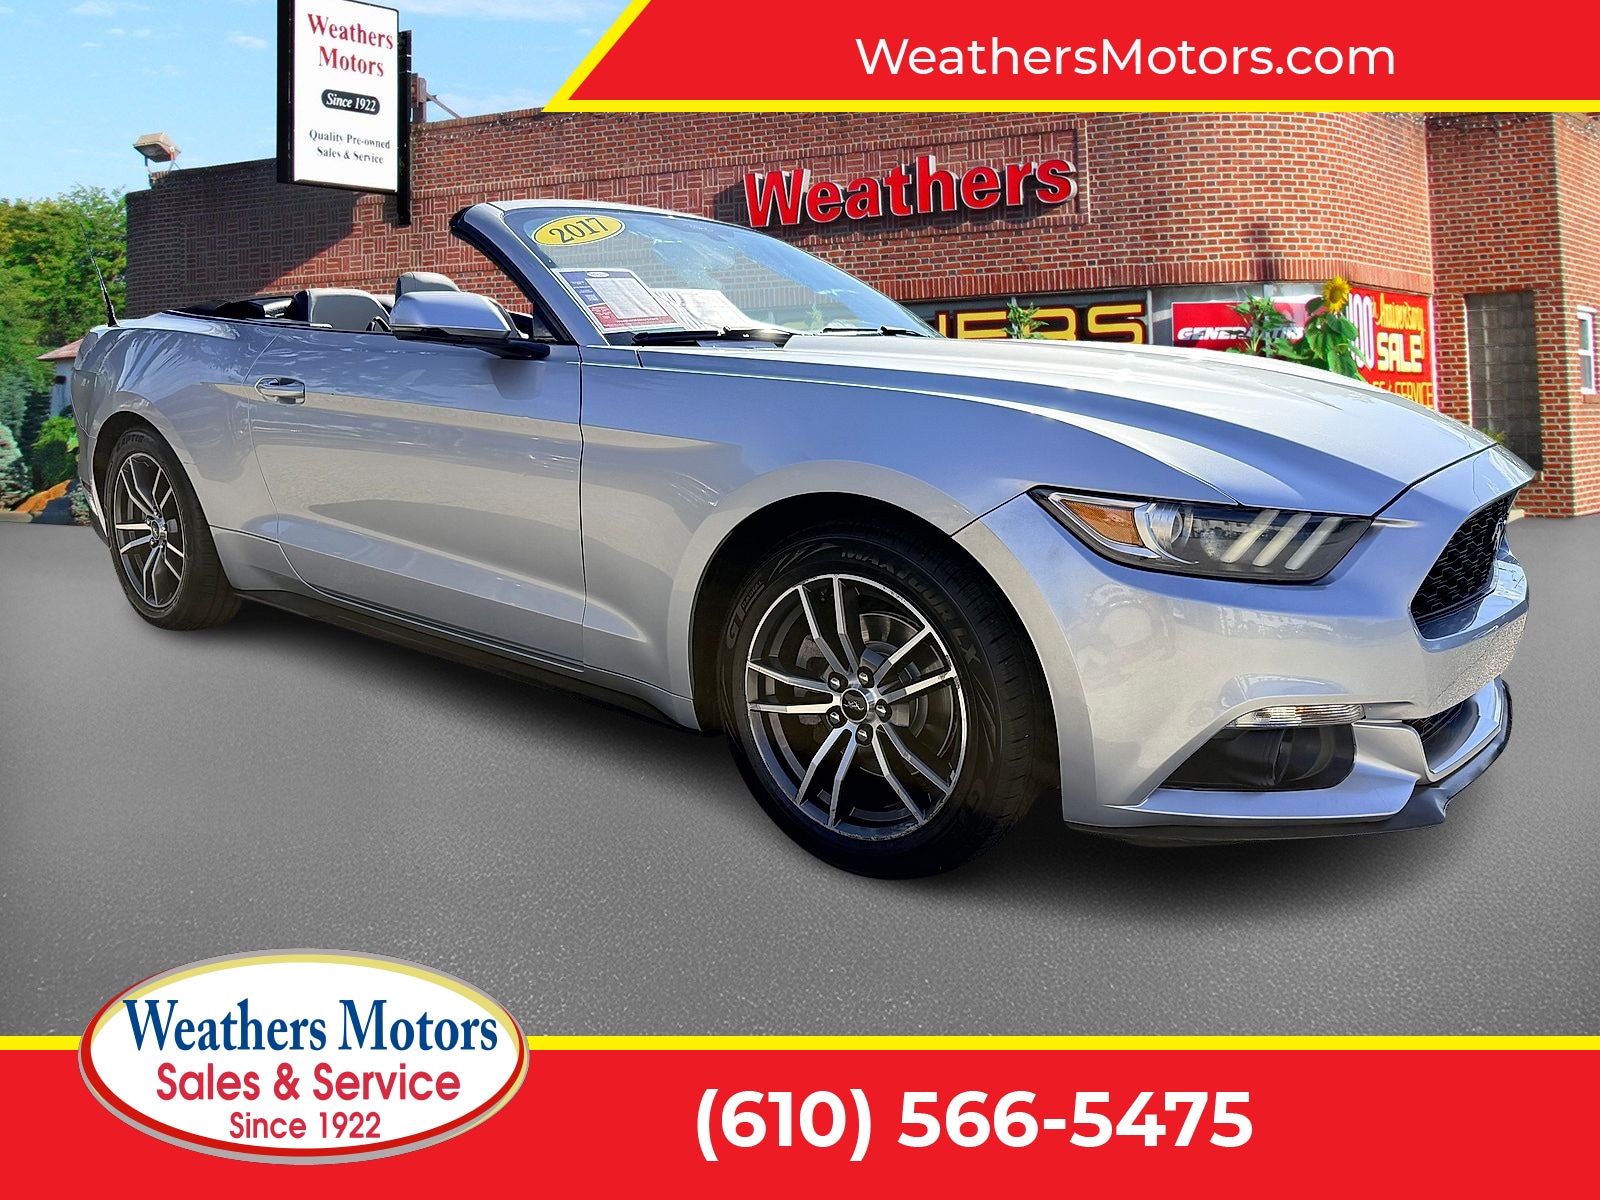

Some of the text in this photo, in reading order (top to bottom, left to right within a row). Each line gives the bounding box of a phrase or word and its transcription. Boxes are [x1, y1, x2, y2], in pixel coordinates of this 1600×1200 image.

[307, 13, 394, 50] Weathers
[318, 45, 385, 77] Motors
[326, 92, 376, 112] Since 1922
[309, 129, 391, 149] Quality Pre-owned
[316, 146, 384, 164] Sales & Service
[743, 155, 1078, 227] Weathers
[549, 217, 609, 244] 2017
[1376, 332, 1423, 373] SALE
